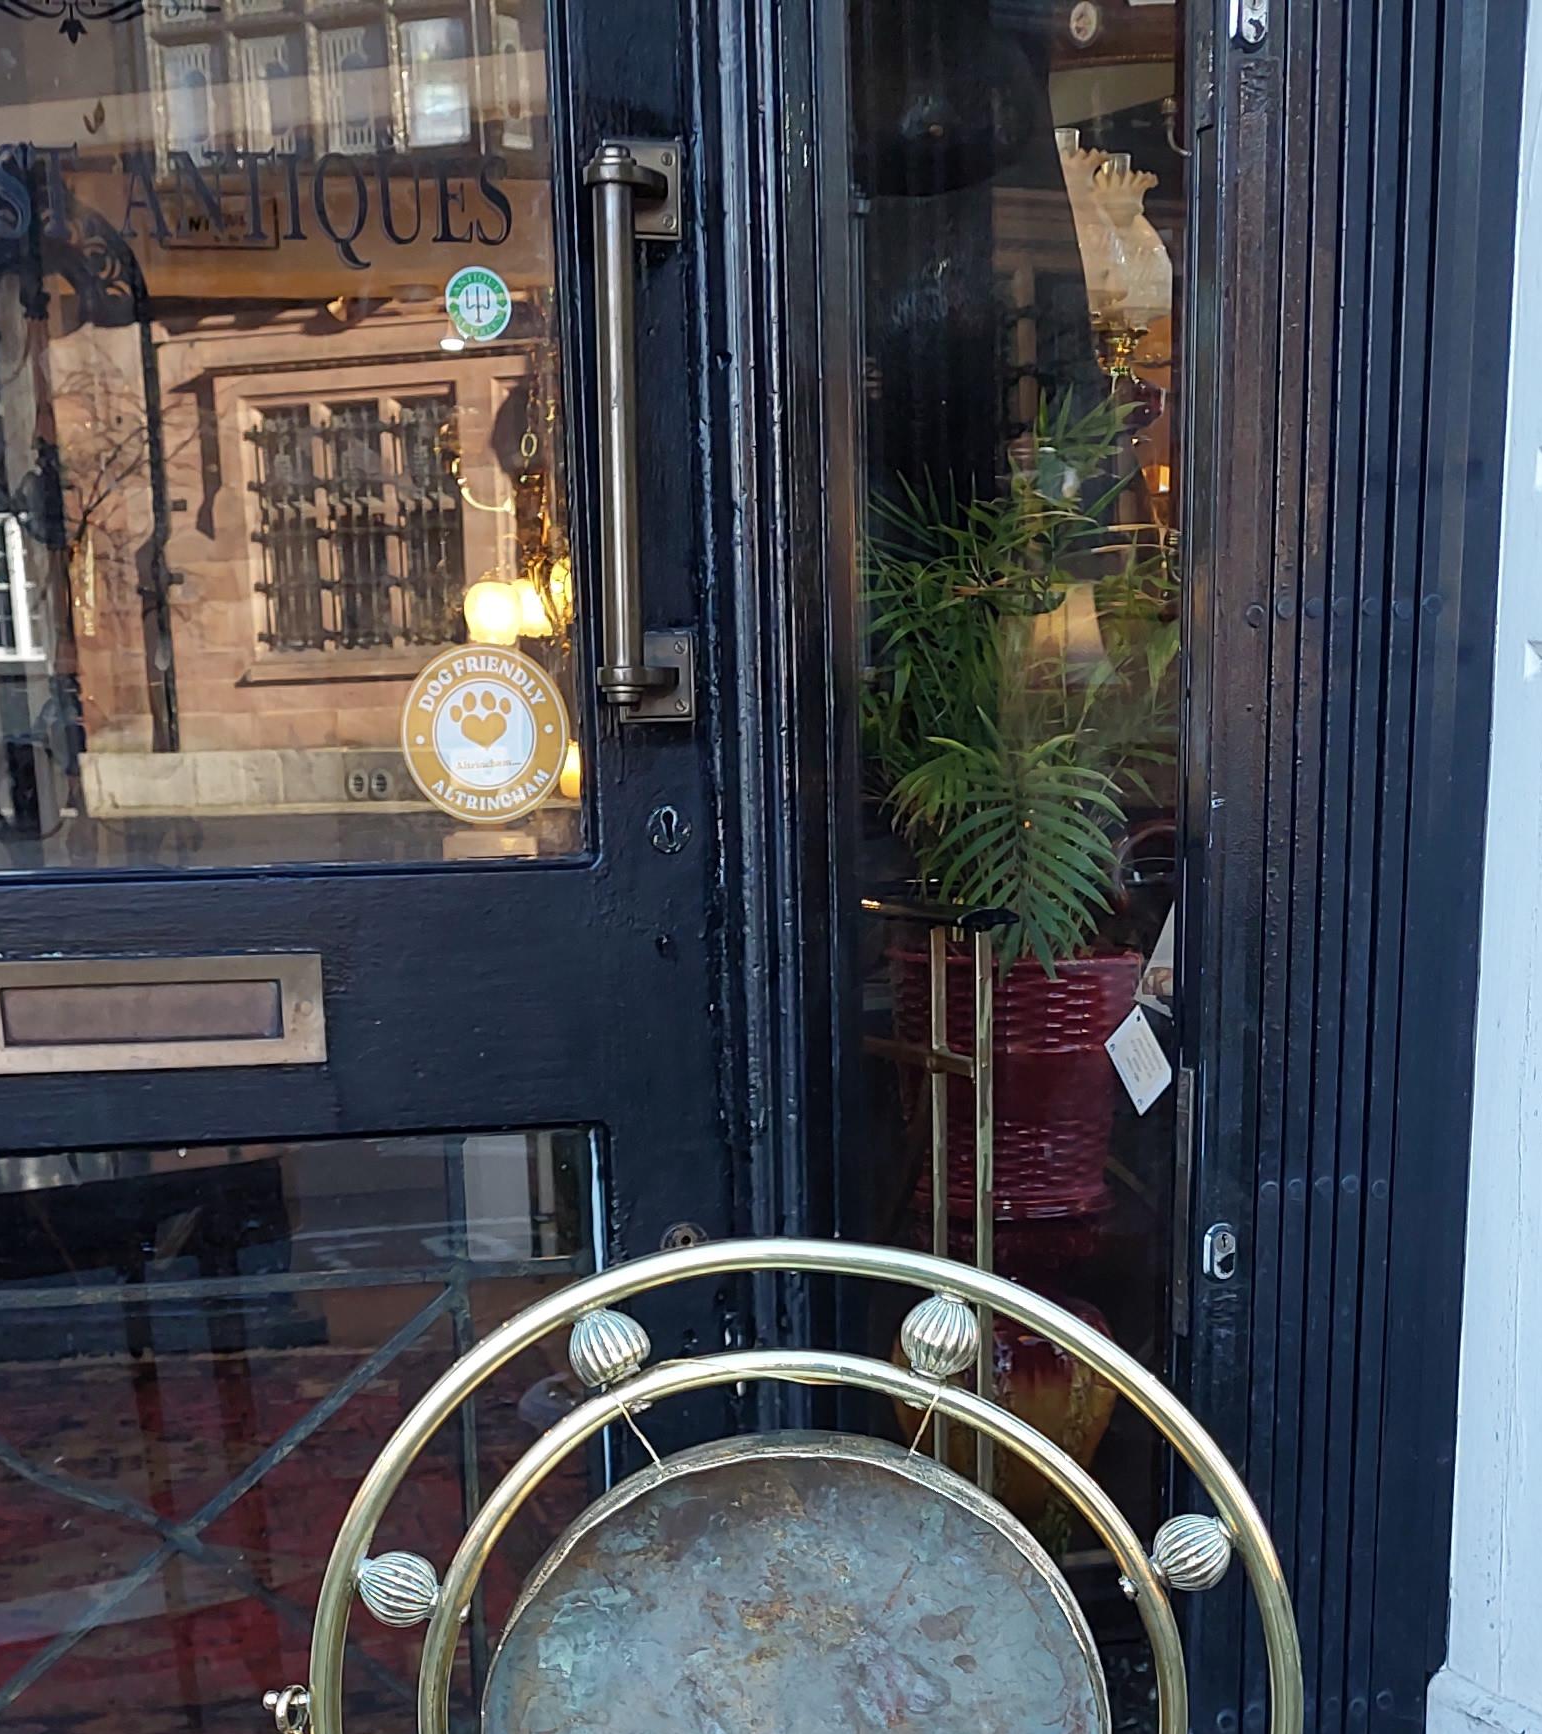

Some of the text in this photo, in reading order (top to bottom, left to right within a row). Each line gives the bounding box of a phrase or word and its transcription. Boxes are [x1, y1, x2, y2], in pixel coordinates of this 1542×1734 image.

[119, 147, 513, 268] ANTIQUES
[418, 655, 547, 713] DOG FRIENDLY
[431, 768, 551, 811] ALTRINCHAM
